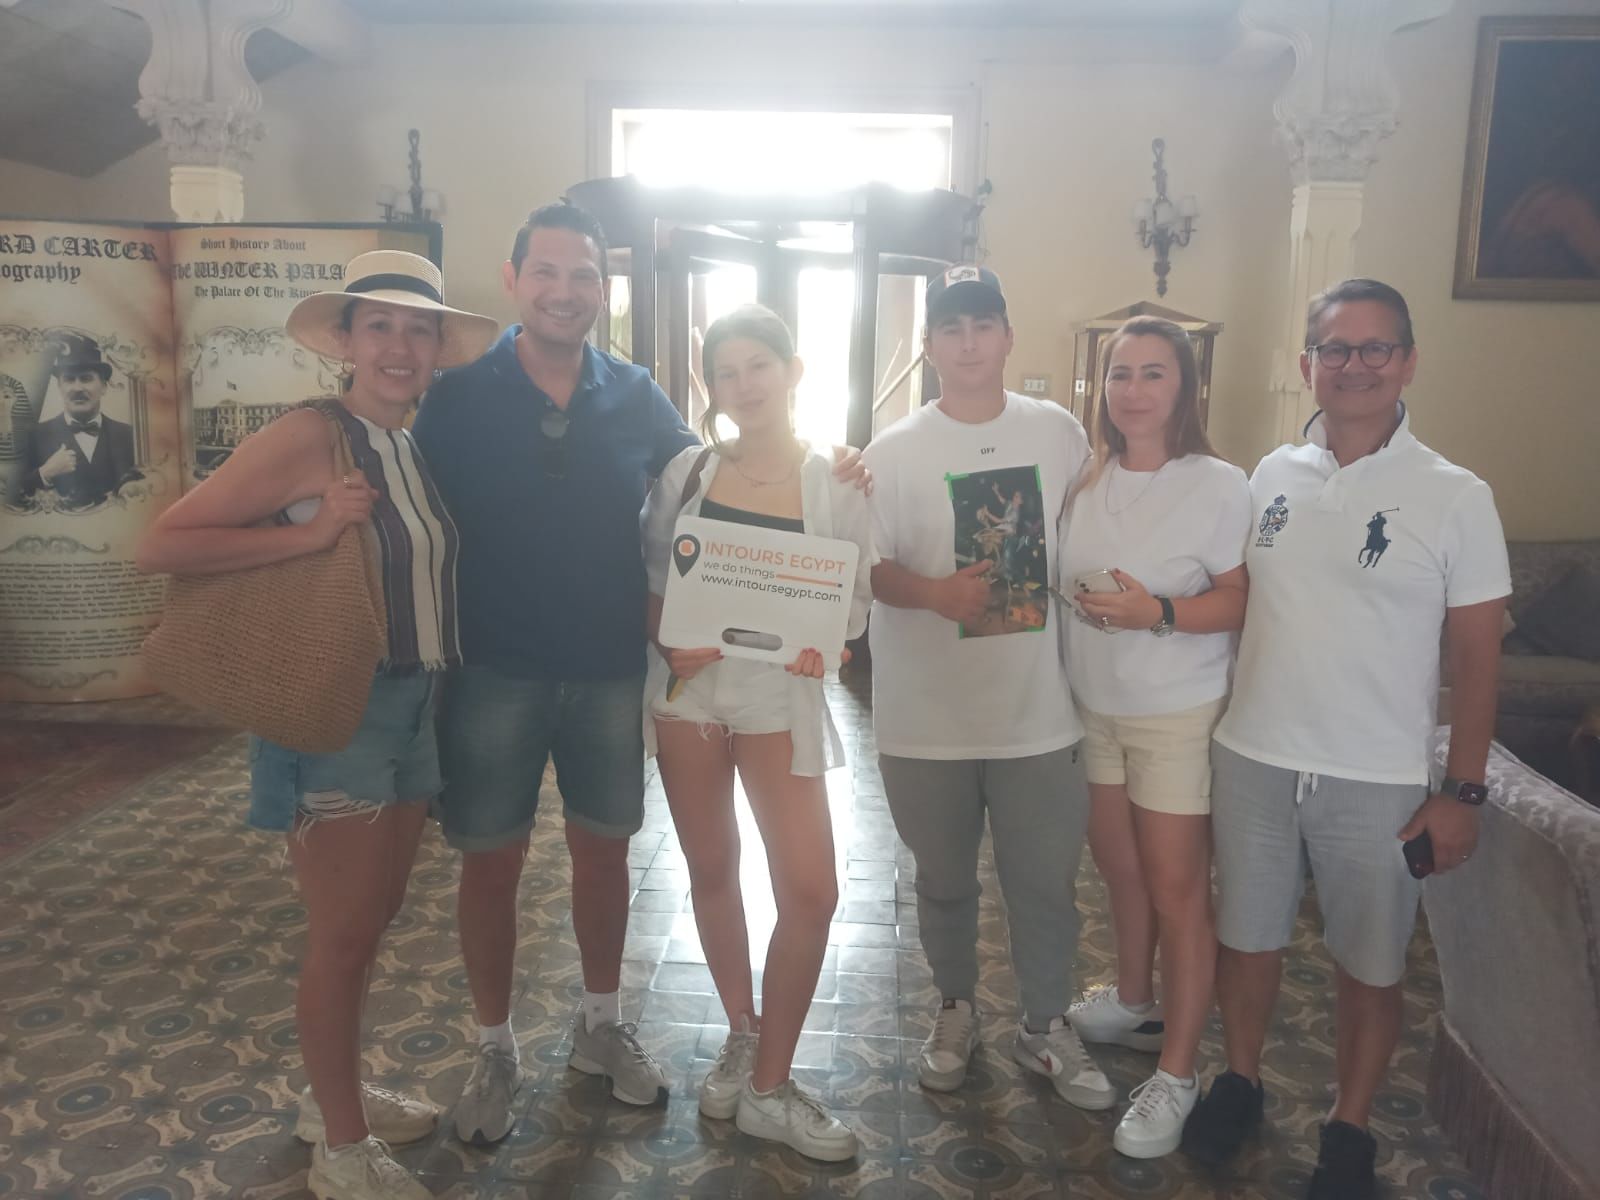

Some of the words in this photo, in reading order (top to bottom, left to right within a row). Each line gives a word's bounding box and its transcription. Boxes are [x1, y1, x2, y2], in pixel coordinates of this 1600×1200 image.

[44, 236, 158, 262] CARTER
[201, 238, 225, 249] Short
[229, 238, 269, 251] History
[273, 239, 306, 250] About
[194, 261, 279, 280] WINTER
[285, 263, 346, 282] PALA
[194, 286, 208, 297] The
[211, 286, 241, 299] Palace
[244, 286, 259, 297] Of
[264, 286, 285, 298] The
[704, 541, 785, 566] INTOURS
[790, 554, 847, 575] EGYPT
[703, 560, 720, 571] we
[722, 562, 737, 574] do
[740, 564, 775, 579] things
[701, 573, 841, 602] www.intoursegypt.com
